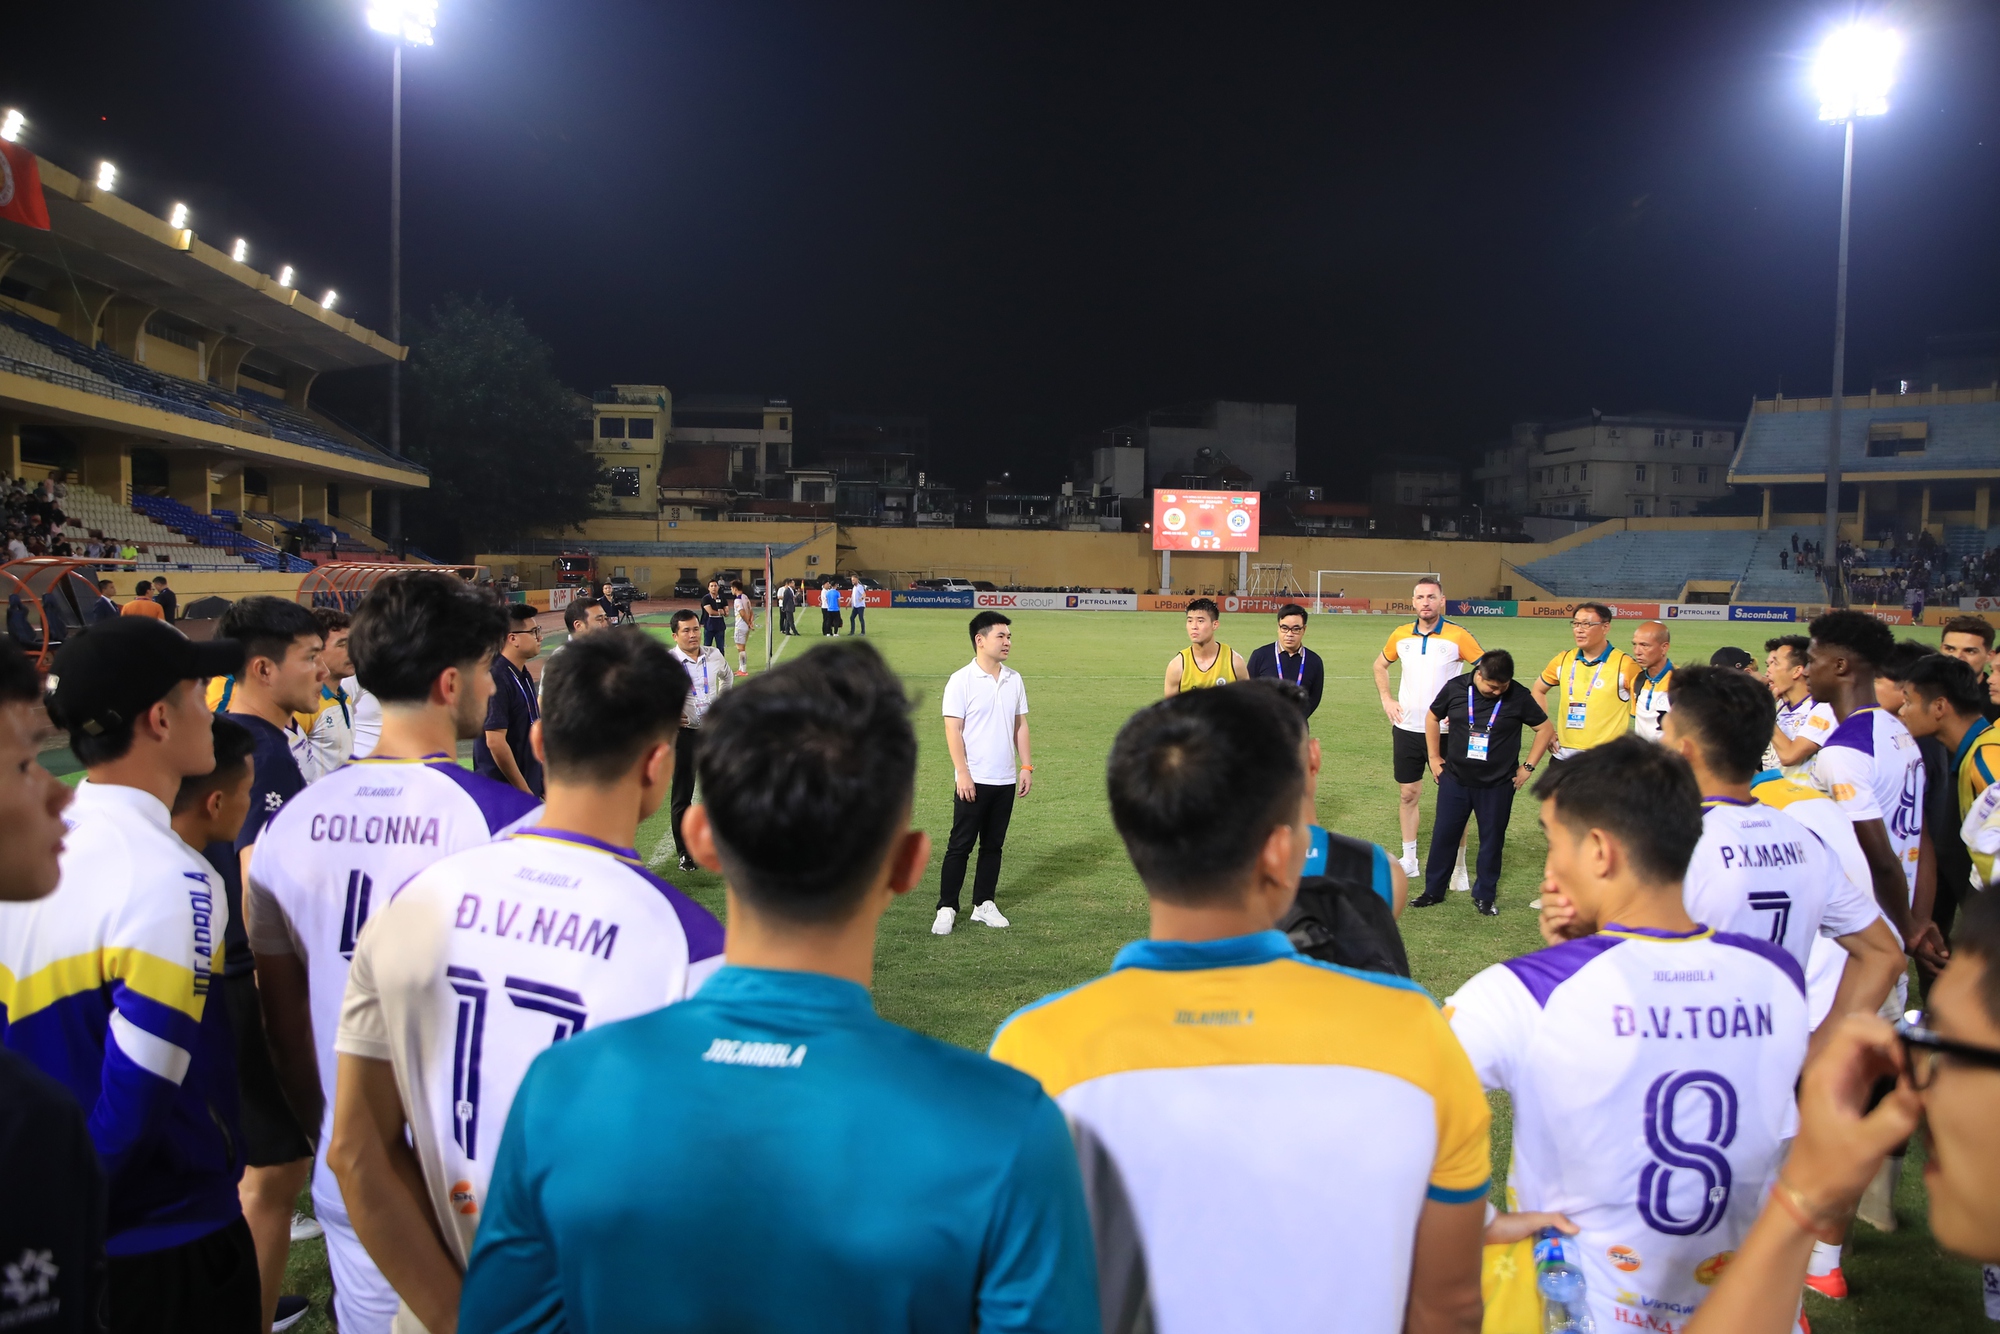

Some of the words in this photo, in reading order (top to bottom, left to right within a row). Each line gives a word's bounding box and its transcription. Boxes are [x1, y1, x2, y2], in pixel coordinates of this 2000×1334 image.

[1191, 536, 1200, 548] 0
[1212, 537, 1220, 548] 2
[932, 596, 961, 604] Airlines
[978, 595, 1017, 606] GELEX
[1020, 599, 1053, 607] GROUP
[1155, 601, 1188, 609] LPBank
[1241, 600, 1260, 610] FPT
[1262, 600, 1284, 611] Play
[1472, 606, 1505, 615] VPBank
[1533, 607, 1565, 616] LPBank
[1618, 608, 1642, 617] Shopee
[1735, 608, 1788, 620] Sacombank
[1877, 613, 1901, 624] Play
[310, 813, 440, 847] COLONNA
[1747, 890, 1791, 947] 7
[455, 892, 619, 960] Đ.V.NAM
[1613, 997, 1773, 1040] Đ.V.TOÀN
[1636, 1069, 1738, 1236] 8
[1641, 1294, 1696, 1316] Vinaw
[1614, 1306, 1682, 1334] HANA
